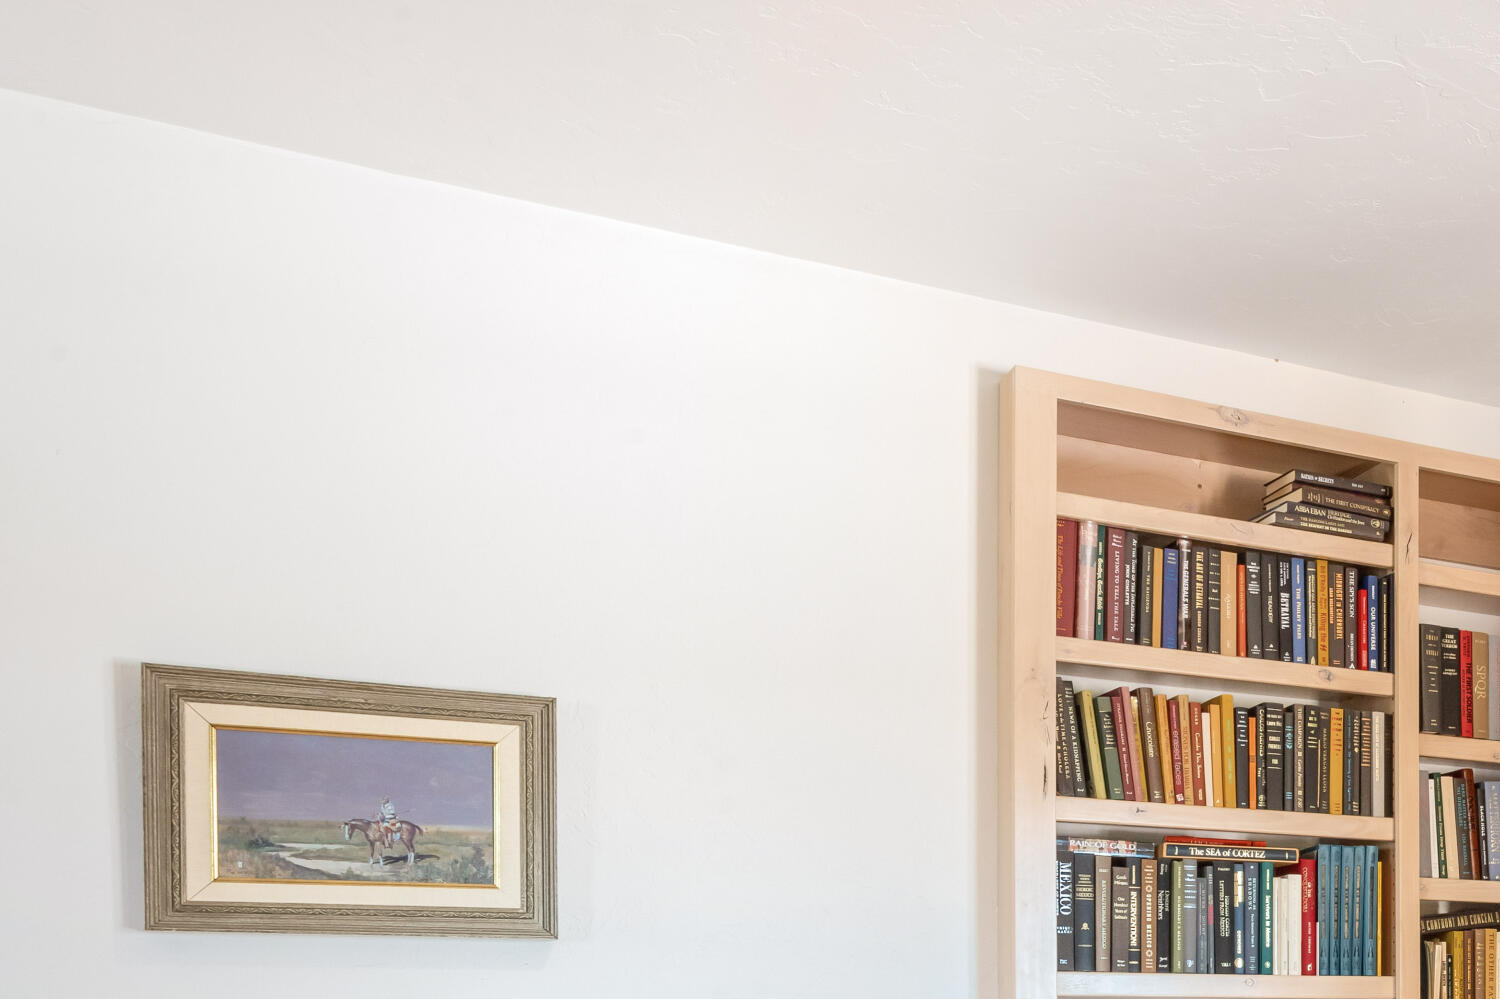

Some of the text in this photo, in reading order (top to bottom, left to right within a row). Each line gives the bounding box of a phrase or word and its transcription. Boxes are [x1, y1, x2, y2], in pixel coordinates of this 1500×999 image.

[1281, 592, 1290, 629] BETRAYAL
[1475, 665, 1486, 700] SPQR
[1173, 730, 1182, 786] erased faces
[1189, 847, 1266, 858] The SEA of CORTEZ
[1060, 861, 1072, 916] MEXICO
